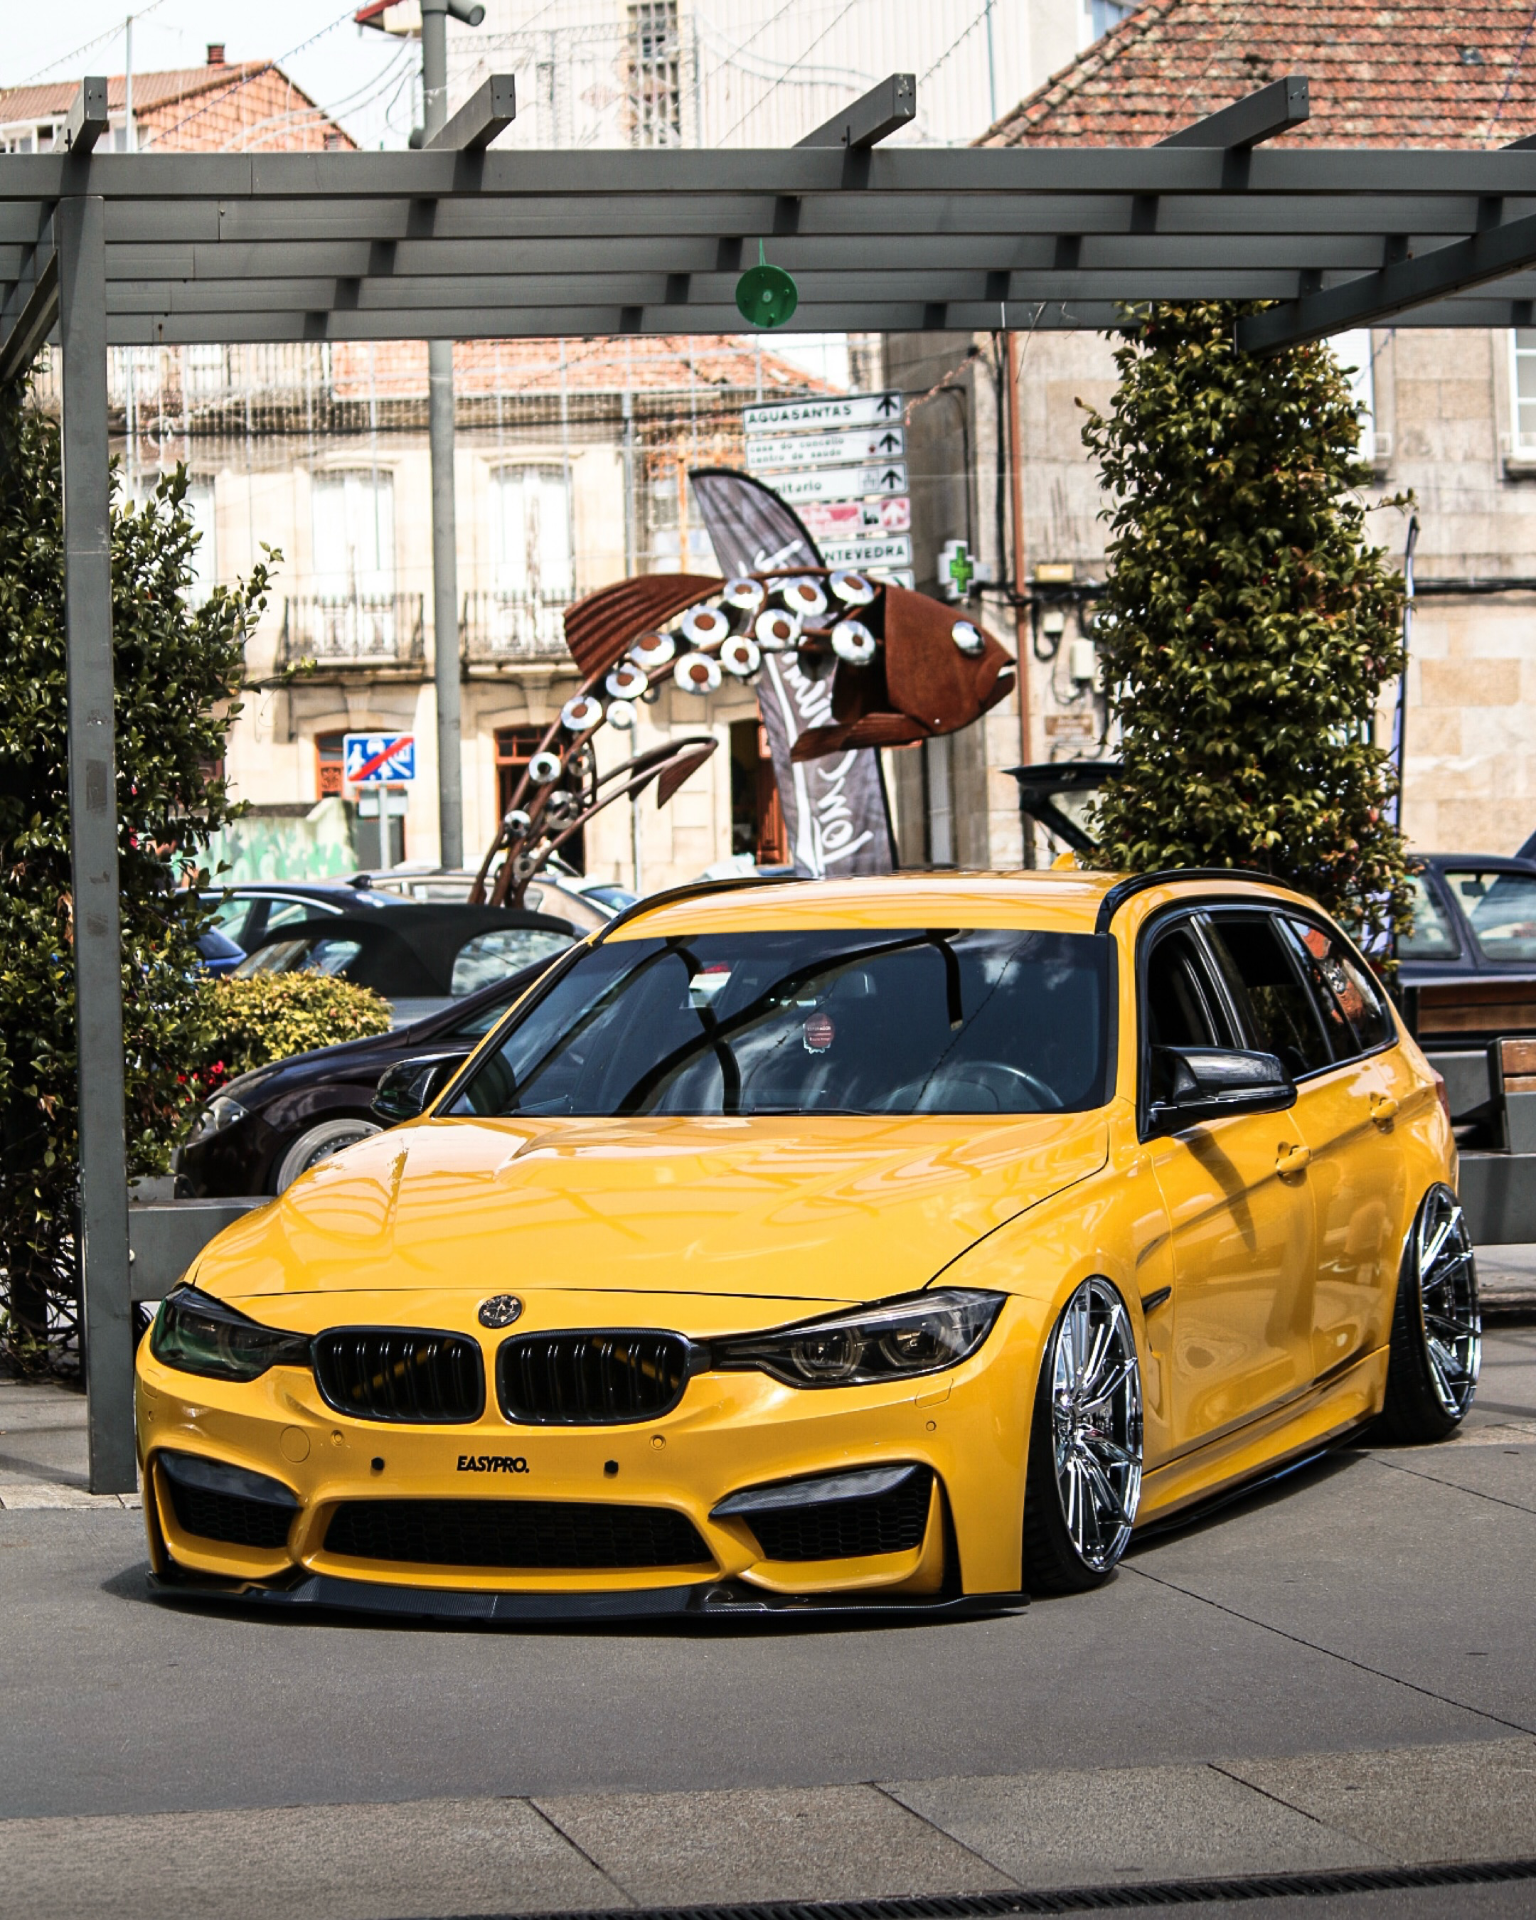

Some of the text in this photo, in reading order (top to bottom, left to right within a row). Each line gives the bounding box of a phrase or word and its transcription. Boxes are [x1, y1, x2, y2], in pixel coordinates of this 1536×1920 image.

[748, 405, 852, 424] AGUASANTAS
[457, 455, 530, 474] EASYPRO.
[824, 545, 905, 561] NTEVEDRA
